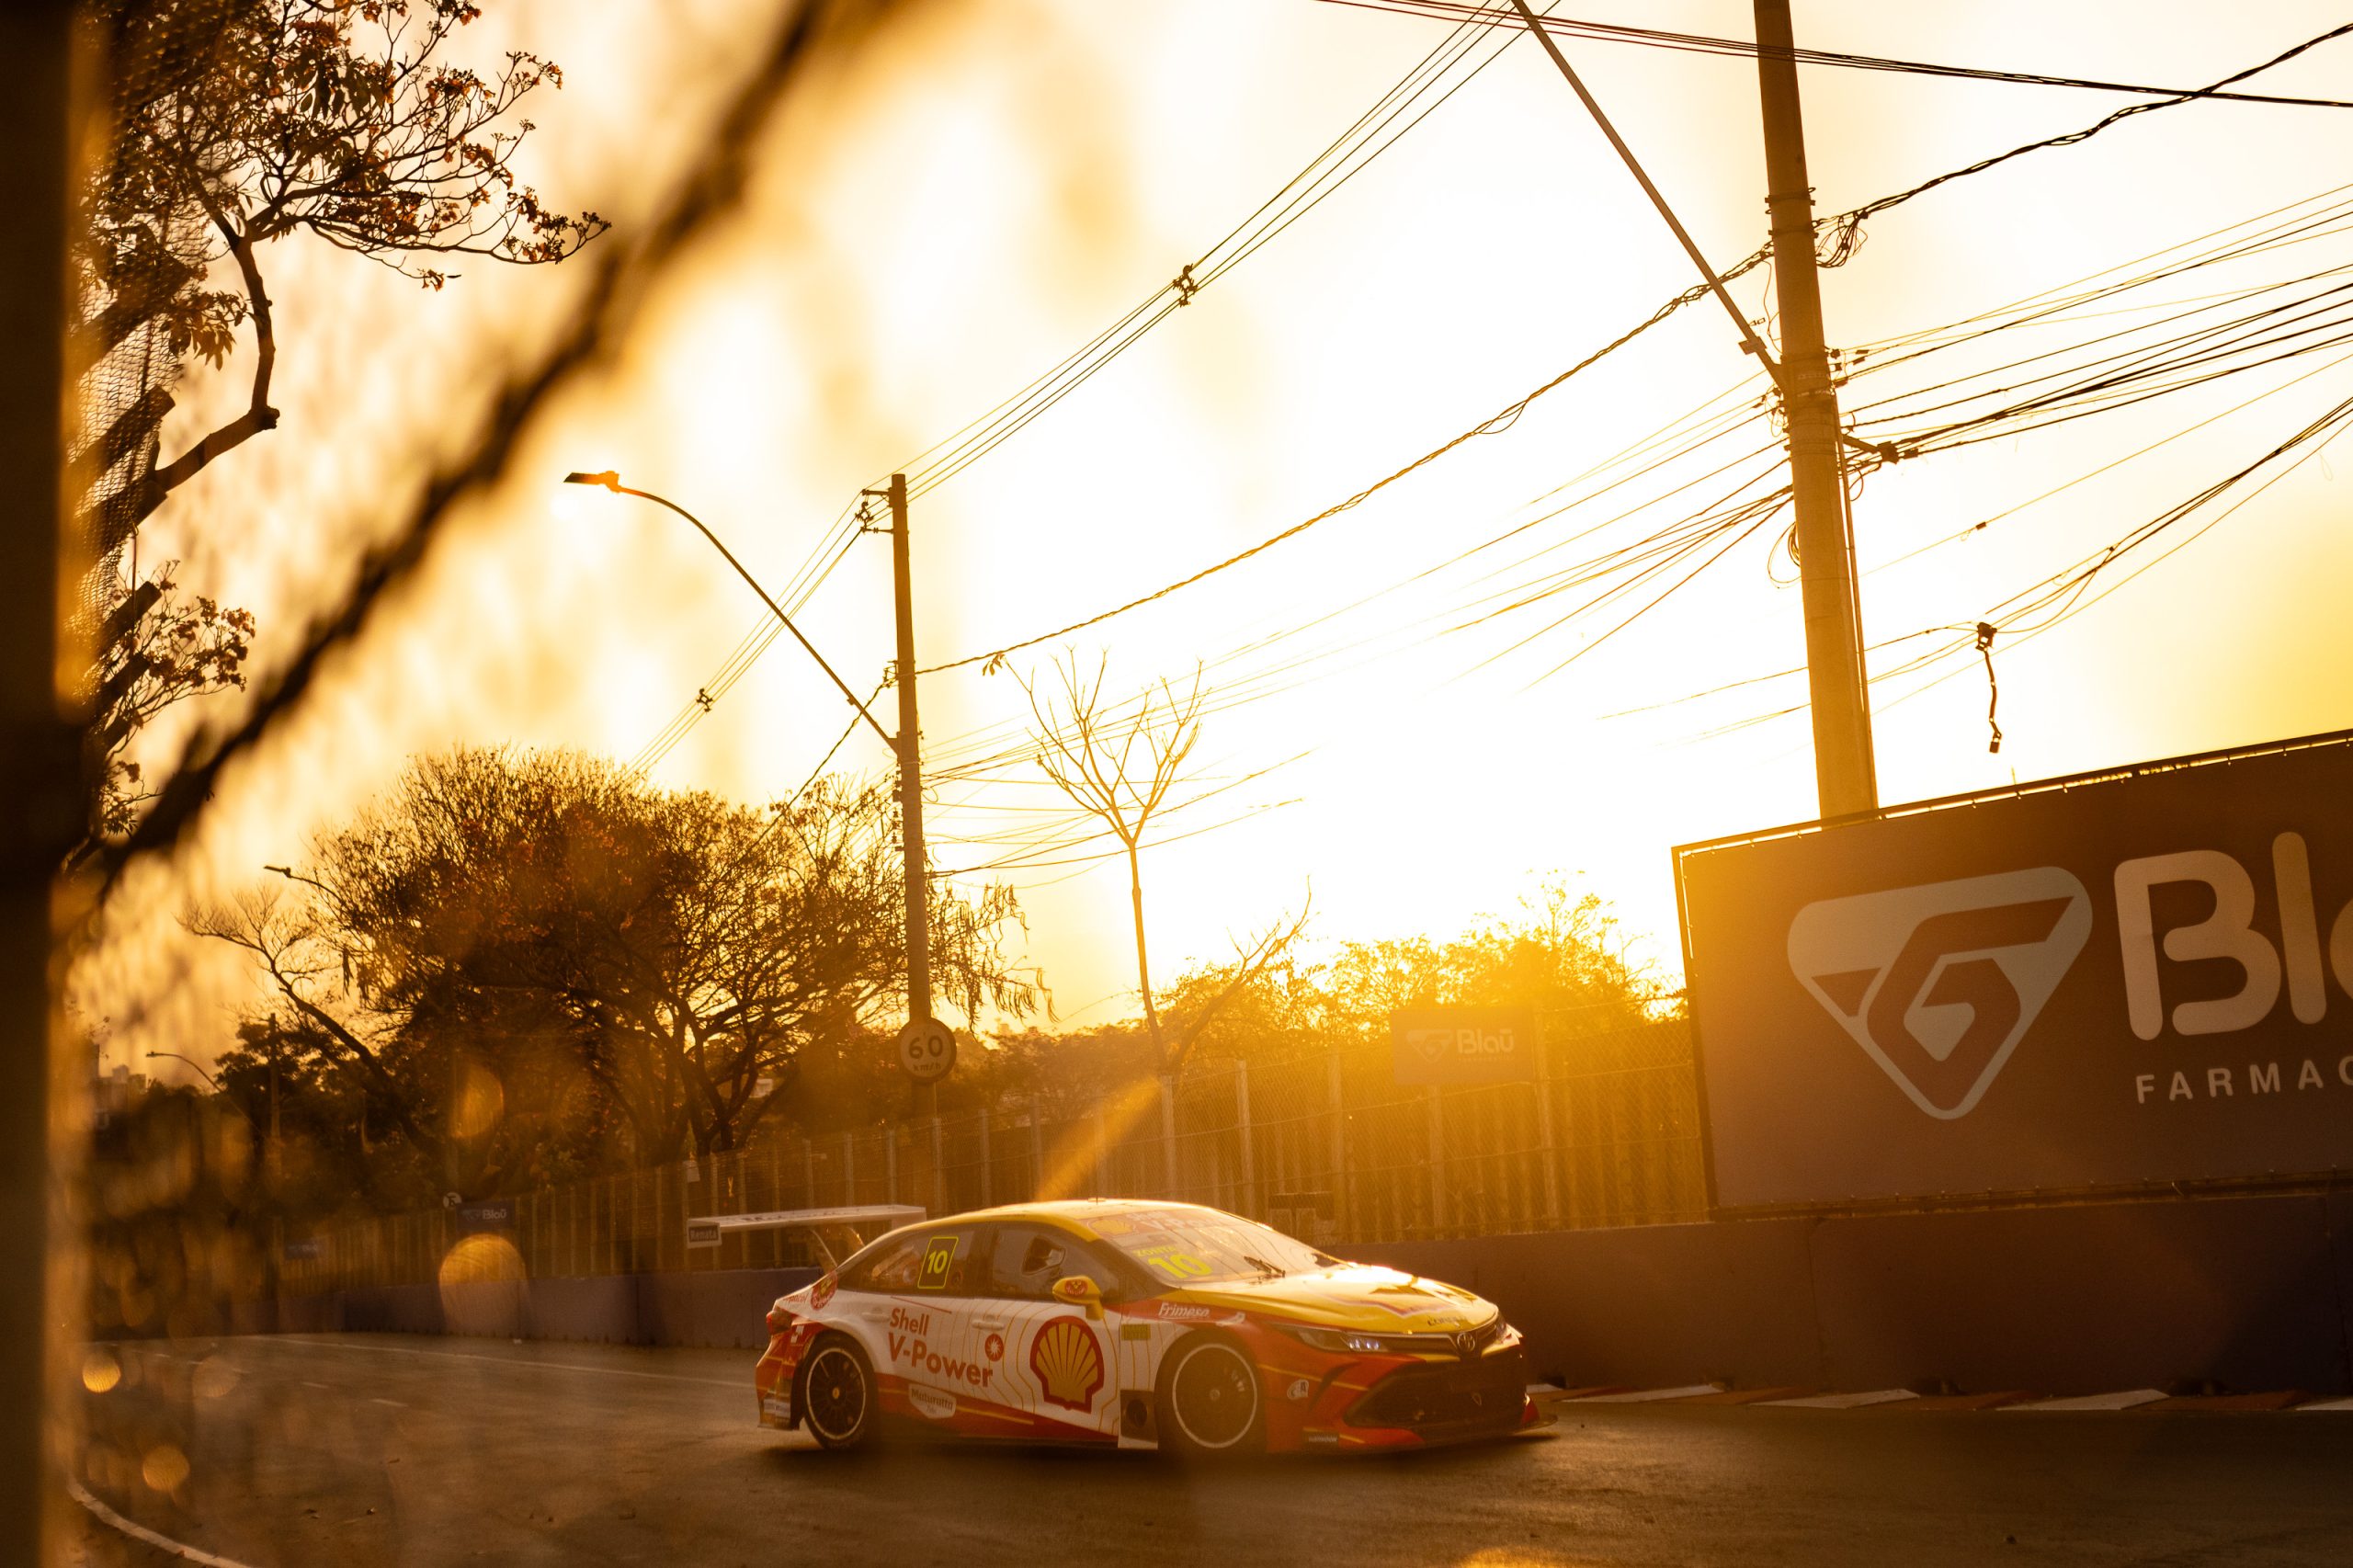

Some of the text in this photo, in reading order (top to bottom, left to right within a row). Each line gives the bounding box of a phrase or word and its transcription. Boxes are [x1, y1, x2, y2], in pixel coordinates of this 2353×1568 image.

[909, 1036, 943, 1059] 60
[926, 1250, 948, 1274] 10
[1148, 1254, 1213, 1278] 10
[890, 1307, 929, 1337] Shell
[888, 1332, 994, 1388] V-Power
